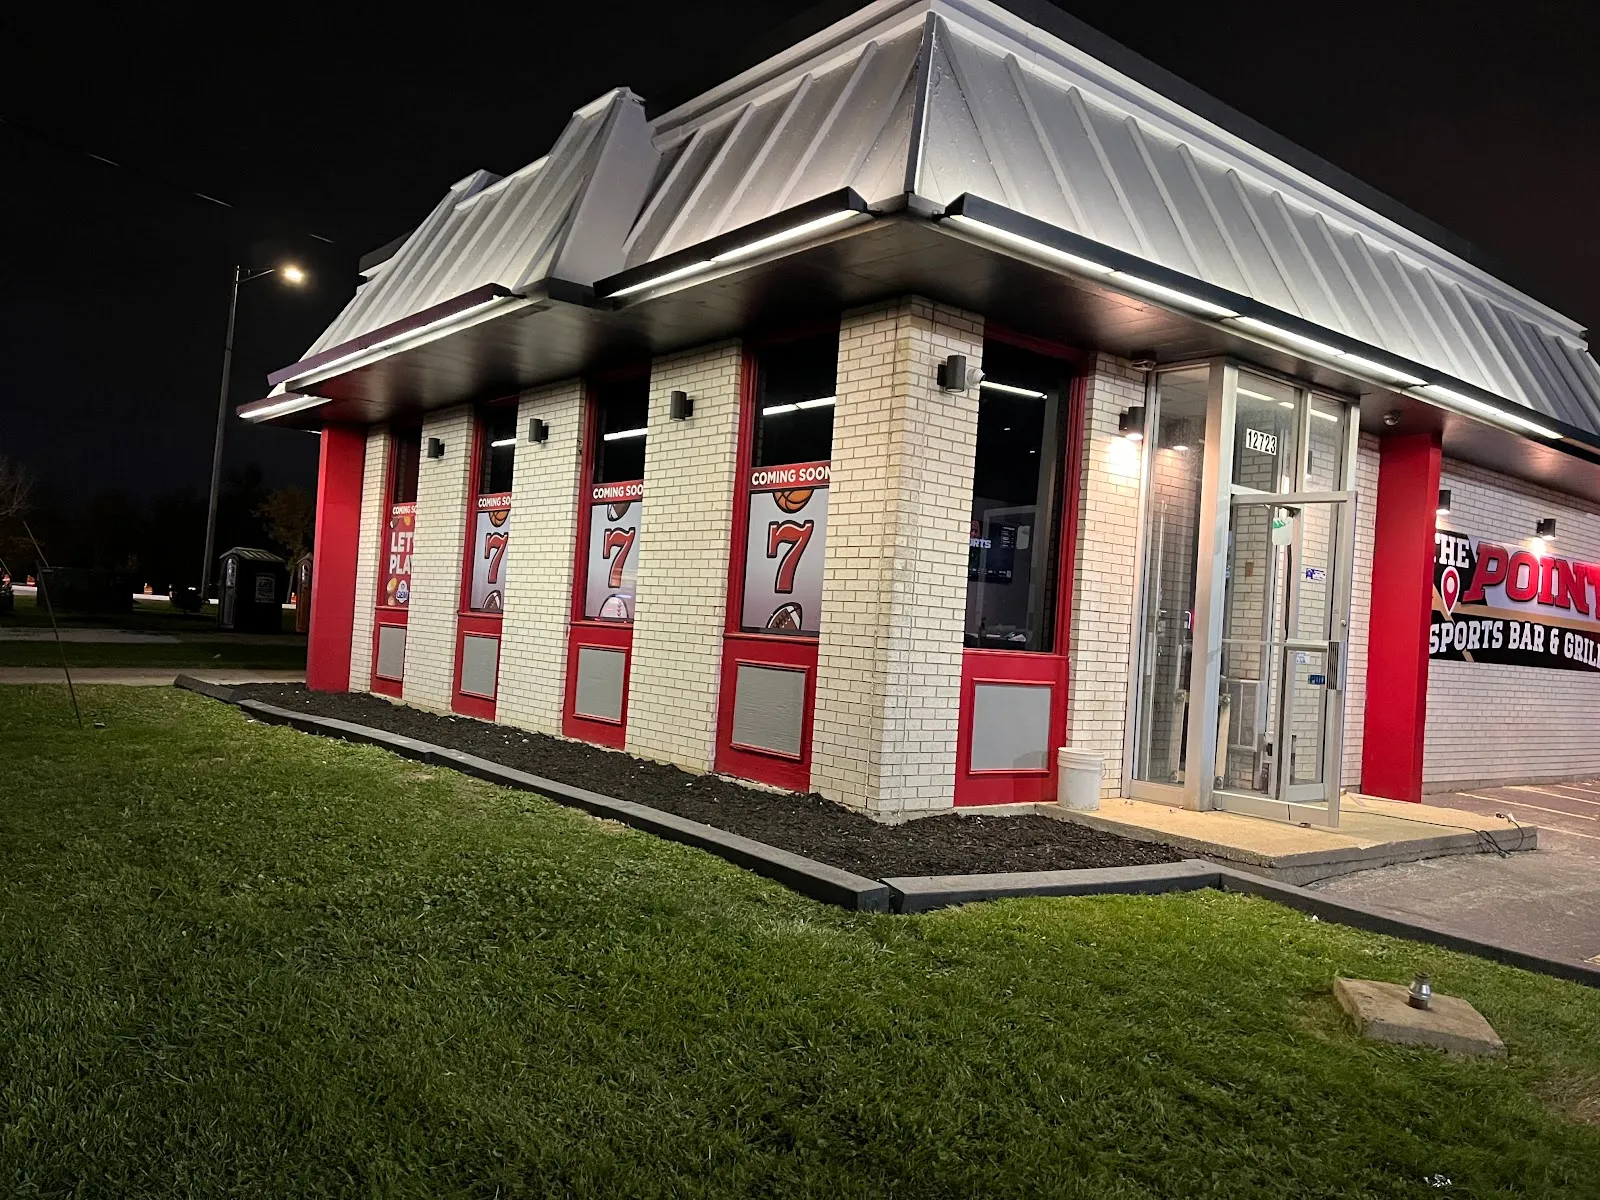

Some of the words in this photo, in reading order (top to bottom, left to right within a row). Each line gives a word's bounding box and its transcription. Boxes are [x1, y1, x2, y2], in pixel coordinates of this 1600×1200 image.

[1248, 430, 1276, 454] 12723
[751, 469, 797, 486] COMING
[478, 497, 501, 508] COMING
[501, 495, 511, 506] SO
[592, 486, 624, 499] COMING
[625, 483, 643, 497] SOO
[390, 531, 414, 553] LET
[388, 553, 412, 575] PLA
[484, 531, 510, 585] 7
[602, 526, 636, 589] 7
[766, 519, 814, 594] 7
[1429, 620, 1504, 655] SPORTS
[1508, 621, 1545, 653] BAR
[1550, 628, 1560, 655] &
